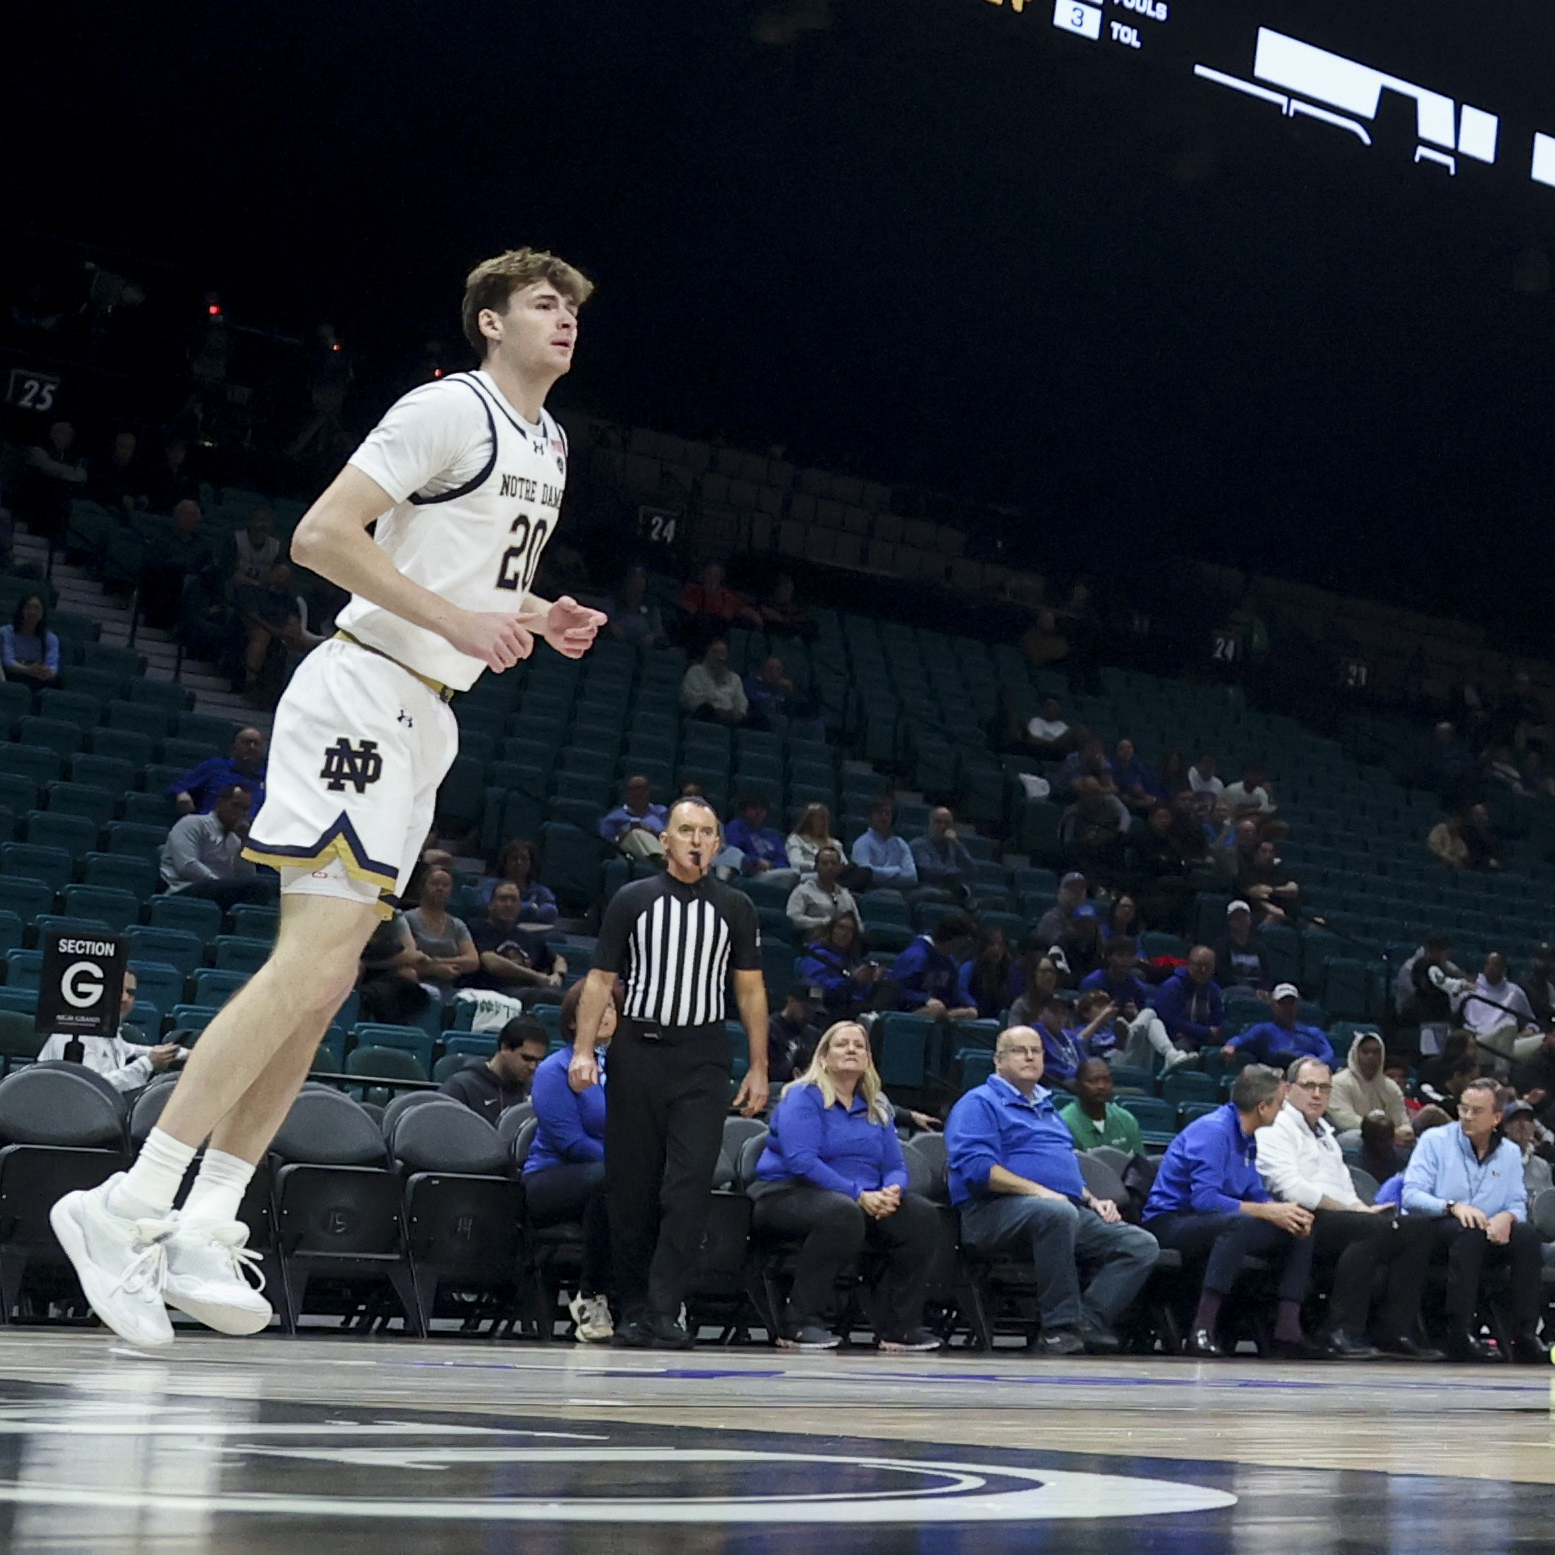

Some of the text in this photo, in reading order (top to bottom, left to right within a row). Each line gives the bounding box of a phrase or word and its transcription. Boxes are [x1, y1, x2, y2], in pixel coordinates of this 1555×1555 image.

[1070, 7, 1142, 49] 3 TOL
[19, 379, 56, 411] 25
[499, 474, 538, 503] NOTRE
[651, 517, 676, 543] 24
[496, 513, 548, 592] 20
[58, 938, 115, 957] SECTION
[61, 961, 104, 1008] G
